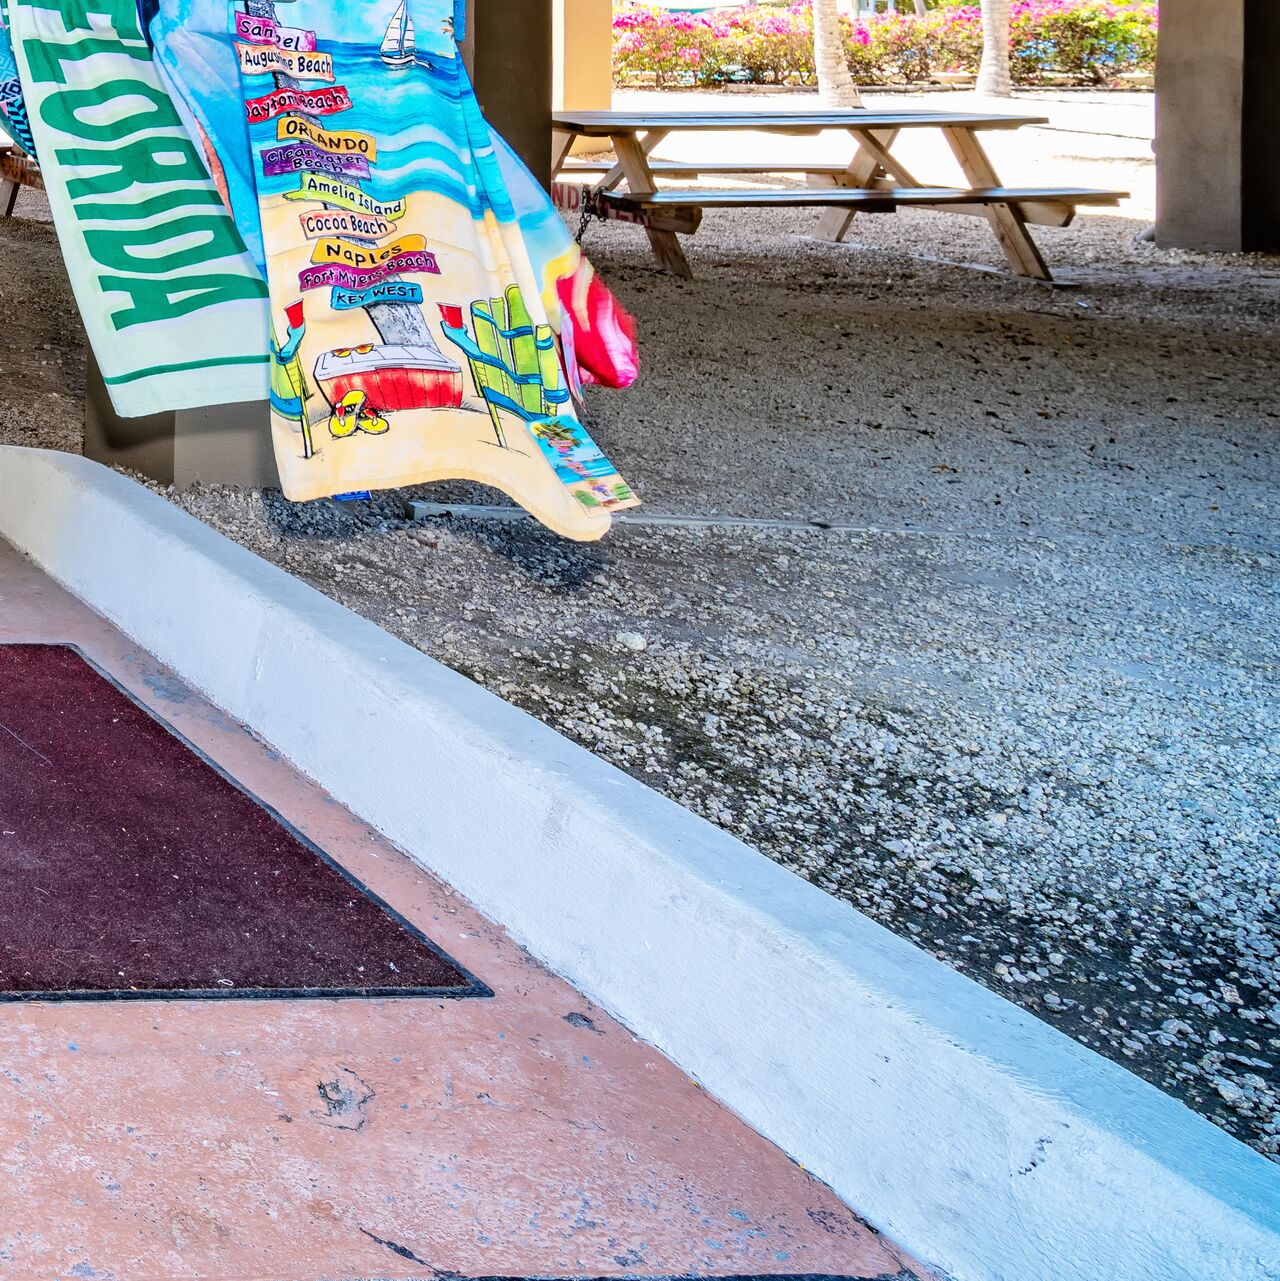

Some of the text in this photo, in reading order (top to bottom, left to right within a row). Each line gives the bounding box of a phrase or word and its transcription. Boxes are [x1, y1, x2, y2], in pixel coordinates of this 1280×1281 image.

[297, 55, 331, 73] Beach
[285, 120, 369, 153] ORLANDO
[267, 148, 362, 164] Clearwater
[293, 158, 343, 173] Beach
[307, 178, 402, 216] Amelia Island
[306, 214, 388, 235] Cocoa Beach
[326, 244, 403, 267] Naples
[304, 254, 434, 288] Fort Myers Beach
[336, 286, 418, 304] KEY WEST
